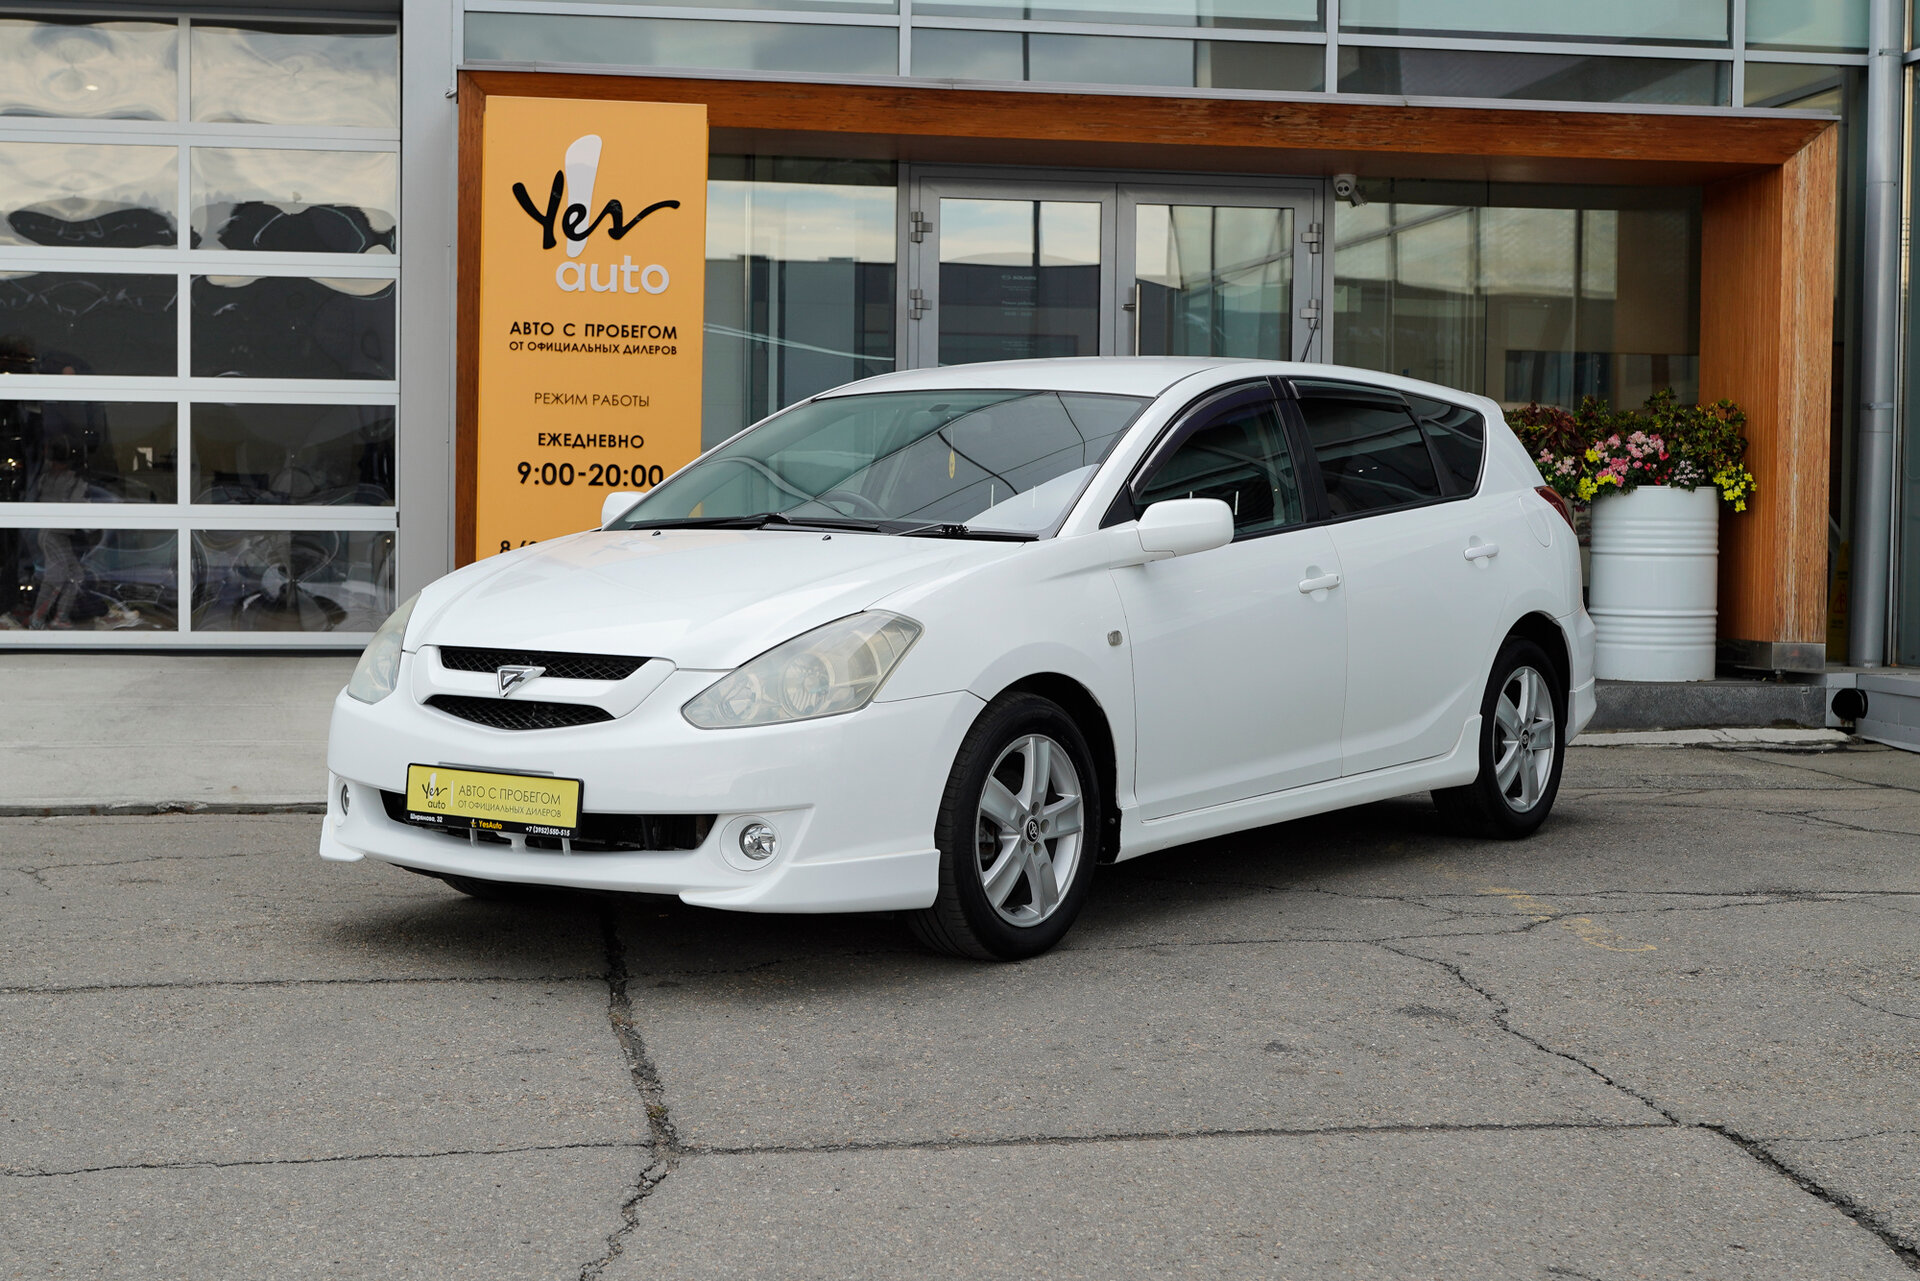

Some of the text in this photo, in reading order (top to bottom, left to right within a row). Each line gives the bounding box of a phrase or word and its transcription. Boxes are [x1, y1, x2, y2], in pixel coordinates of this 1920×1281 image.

[512, 170, 680, 250] Yes
[555, 255, 670, 294] auto
[509, 321, 678, 339] АВТО С ПРОБЕГОМ
[509, 341, 677, 355] ОТ ОФИЦИАЛЬНЫХ ДИЛЕРОВ
[534, 392, 650, 407] РЕЖИМ РАБОТЫ
[537, 432, 645, 449] ЕЖЕДНЕВНО
[517, 461, 664, 488] 9:00-20:00
[458, 785, 561, 805] АВТО С ПРОБЕГОМ
[427, 800, 446, 810] auto
[457, 800, 562, 818] ОТ ОФИЦИАЛЬНЫХ ДИЛЕРОВ
[478, 820, 503, 830] YesAuto
